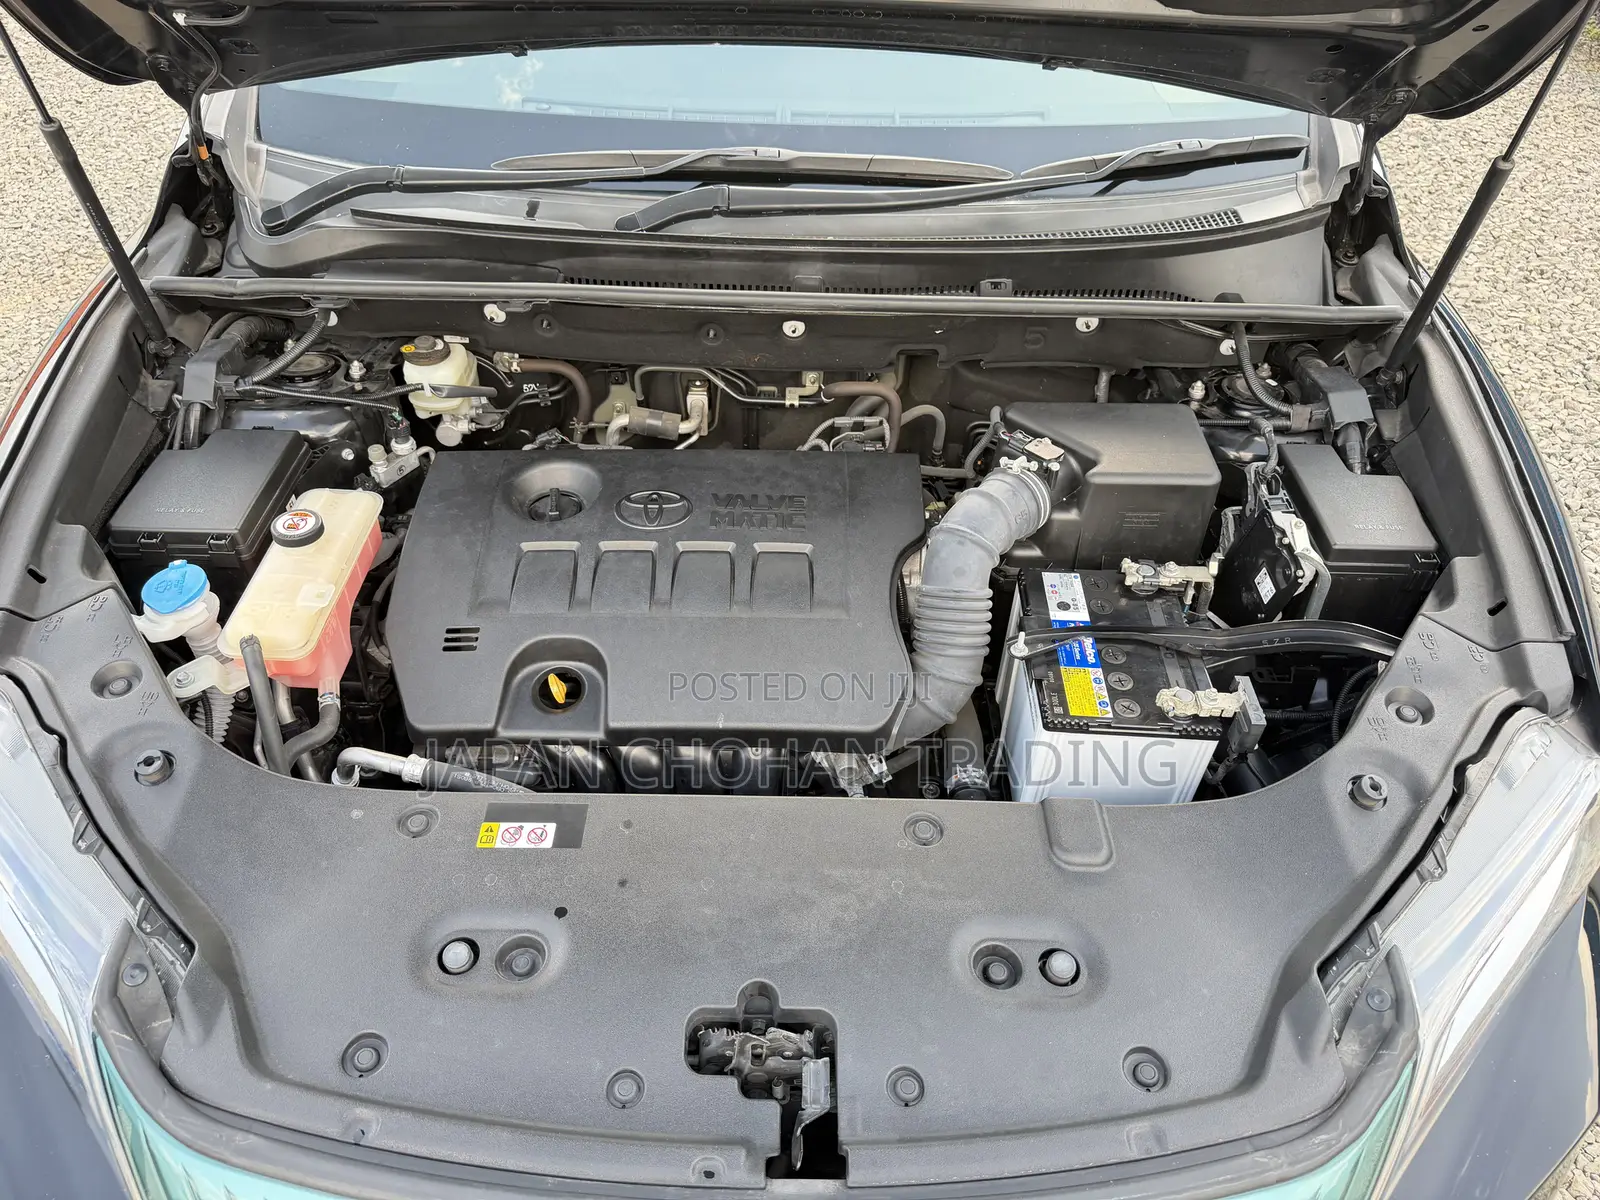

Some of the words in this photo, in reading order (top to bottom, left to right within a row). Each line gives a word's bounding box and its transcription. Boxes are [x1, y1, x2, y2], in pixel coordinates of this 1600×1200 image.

[1024, 326, 1047, 349] 5
[711, 493, 806, 511] VALVE
[709, 510, 806, 531] MATIC
